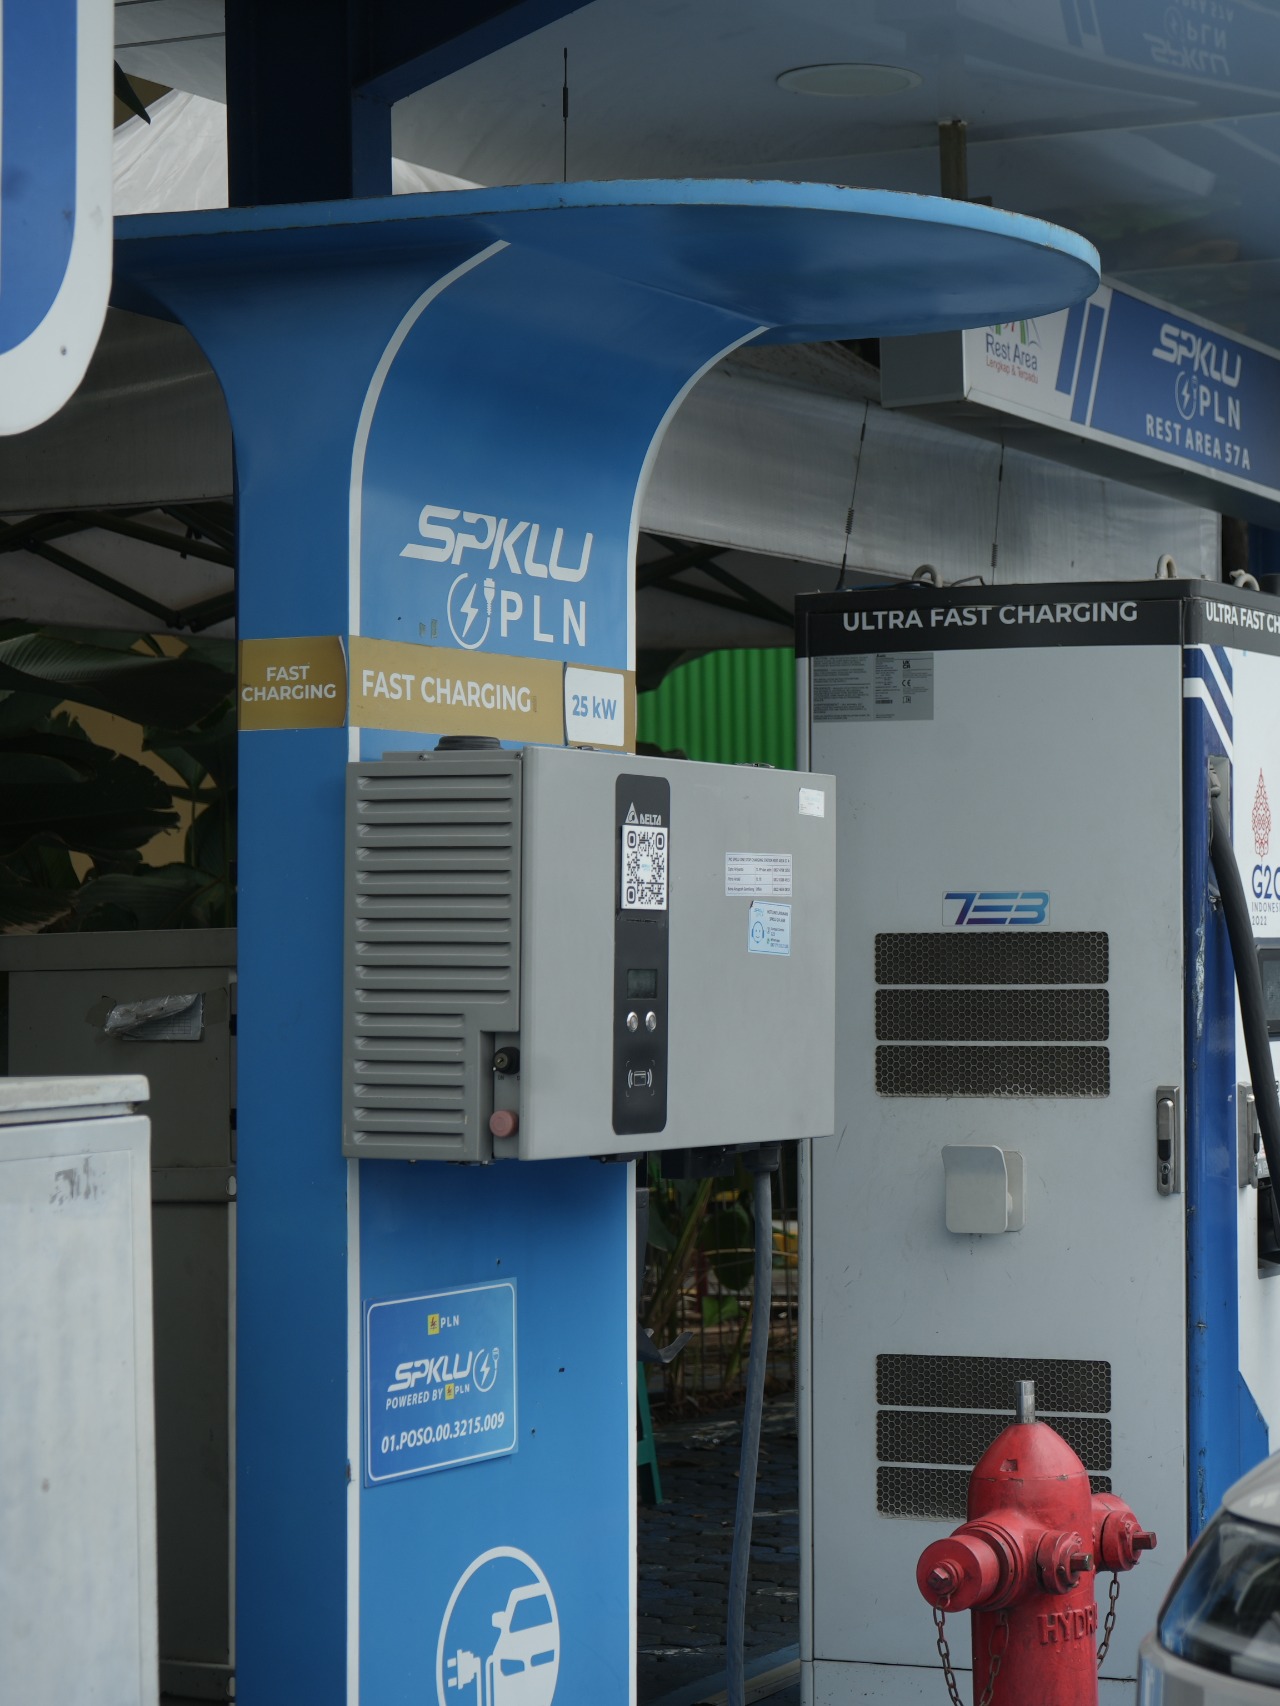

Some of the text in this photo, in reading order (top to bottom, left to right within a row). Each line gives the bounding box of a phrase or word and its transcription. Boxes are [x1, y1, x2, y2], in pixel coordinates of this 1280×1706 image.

[986, 332, 1038, 371] Rest Area
[1152, 323, 1242, 388] SPKLU
[1200, 390, 1241, 431] PLN
[1146, 413, 1251, 471] REST AREA 57A
[399, 504, 593, 583] SPKLU
[500, 590, 587, 647] PLN
[842, 602, 1138, 632] ULTRA FAST CHARGING
[1206, 601, 1238, 626] ULTRA
[1240, 608, 1265, 631] FAST
[266, 665, 310, 682] FAST
[241, 683, 337, 703] CHARGING
[362, 670, 532, 713] FAST CHARGING
[572, 694, 617, 721] 25 kW
[639, 813, 662, 826] DELTA
[1251, 915, 1267, 926] 2022
[440, 1315, 460, 1328] PLN
[387, 1351, 473, 1393] SPKLU
[386, 1384, 470, 1411] POWERED BY PLN
[381, 1411, 505, 1454] 01.POSO.00.3215.009
